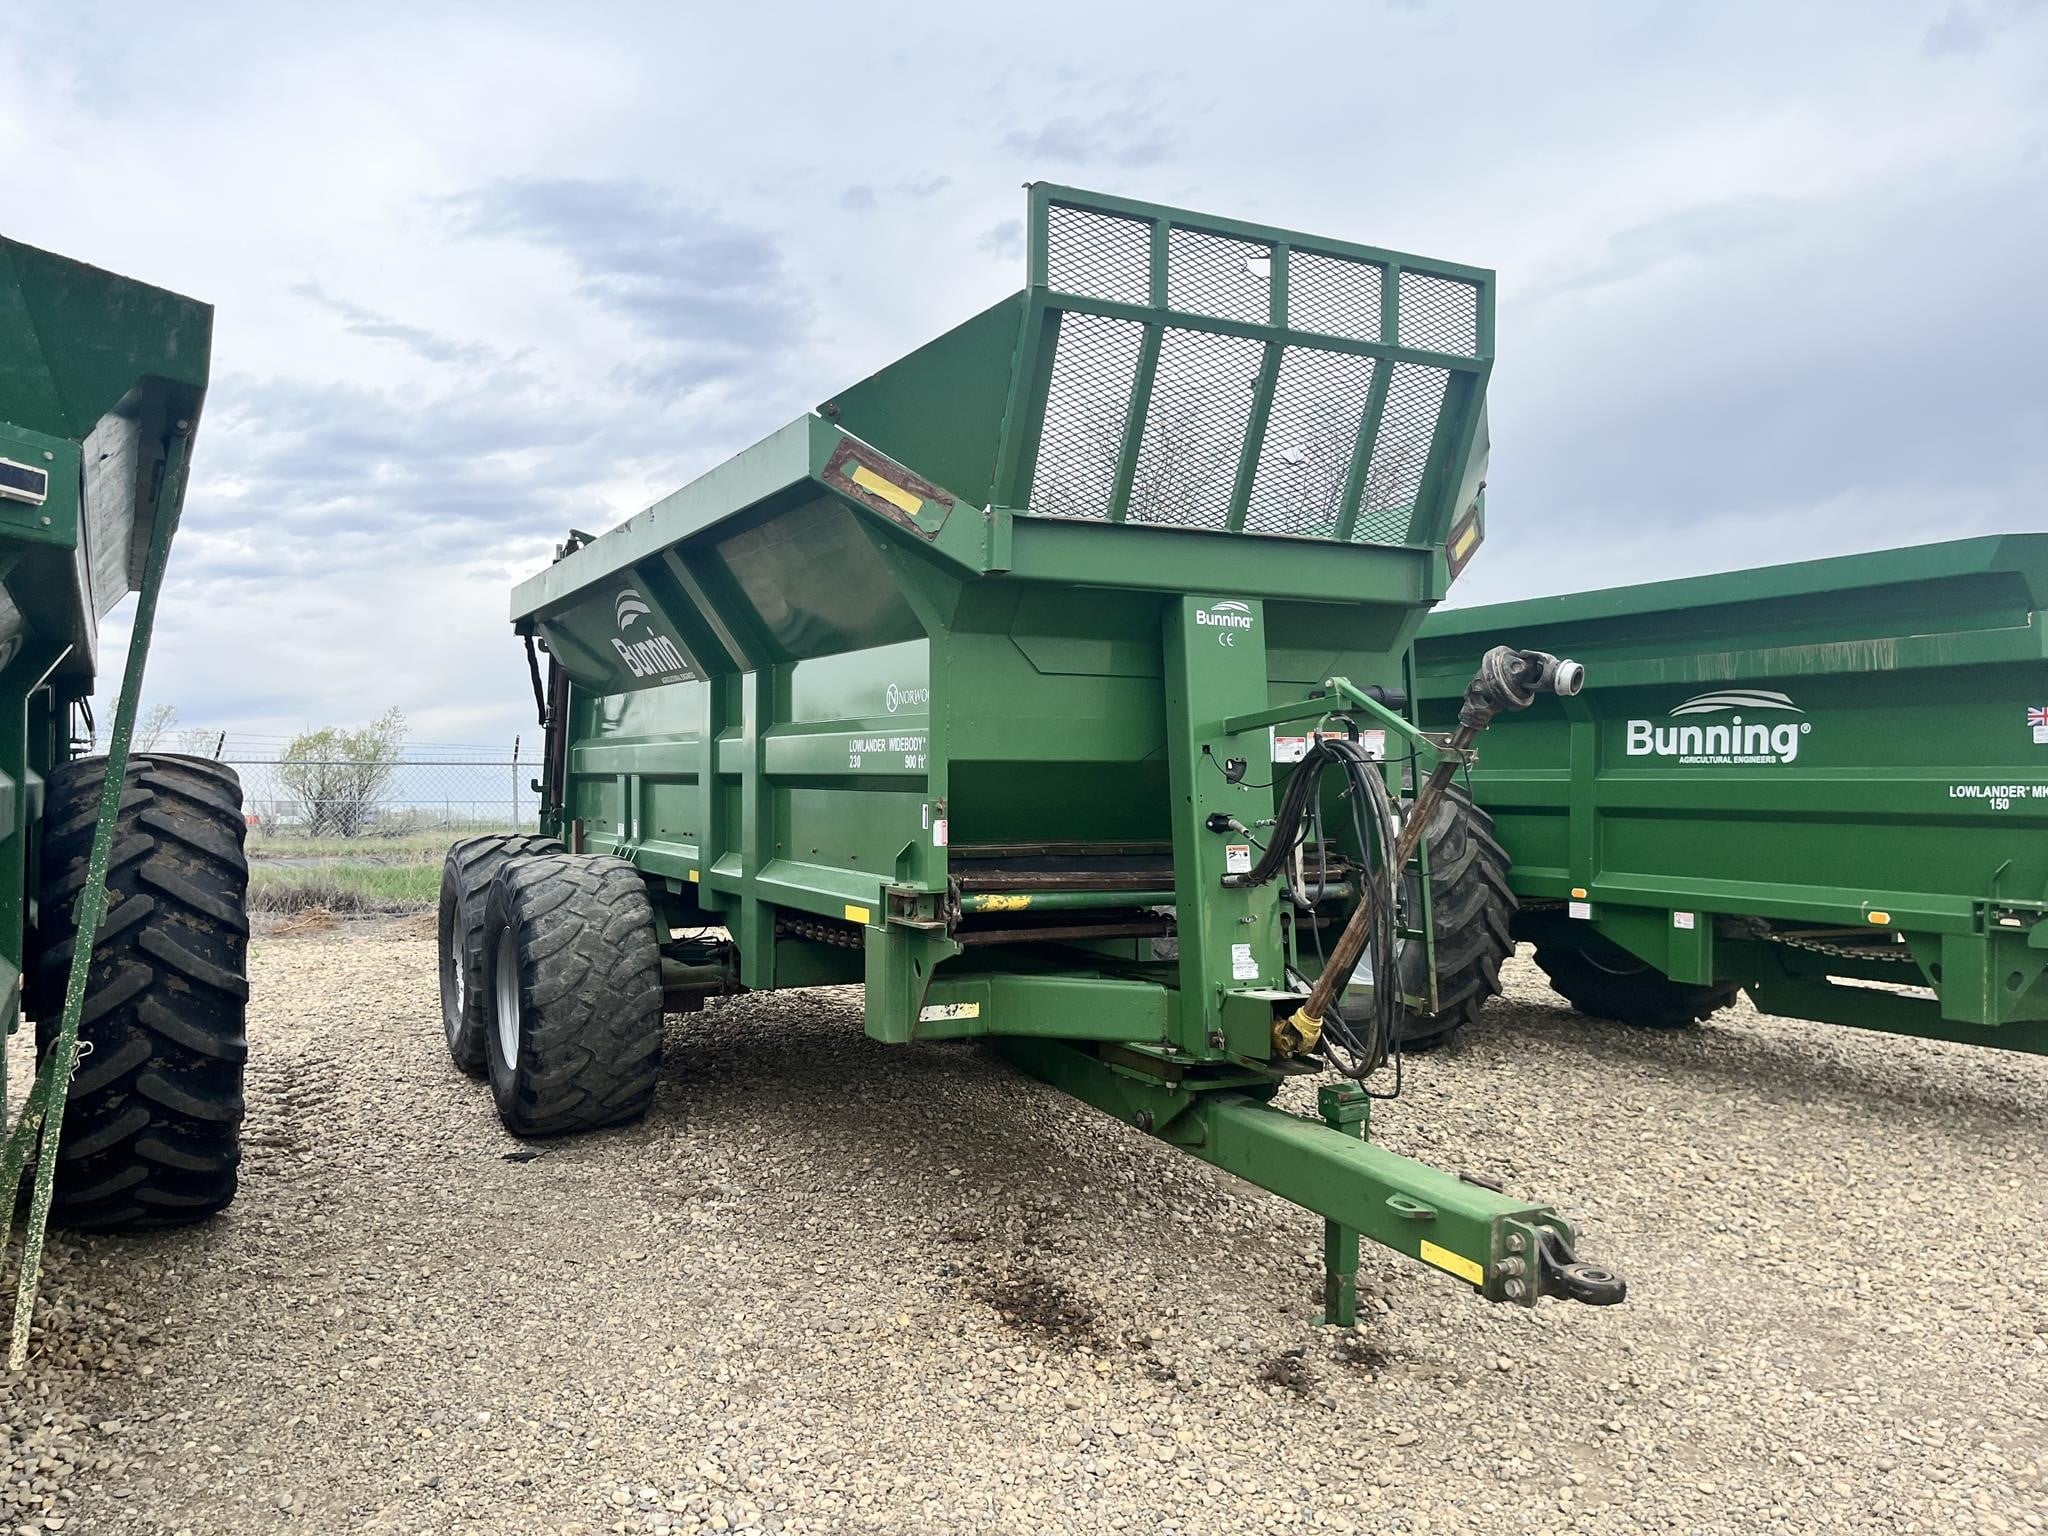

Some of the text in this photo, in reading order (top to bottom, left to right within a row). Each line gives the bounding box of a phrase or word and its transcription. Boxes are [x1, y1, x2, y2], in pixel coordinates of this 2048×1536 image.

[1196, 609, 1251, 631] Bunning
[898, 688, 930, 705] NORWO
[849, 738, 886, 752] LOWLANDER
[849, 754, 861, 768] 230
[904, 754, 917, 768] 900
[1678, 755, 1777, 764] AGRICULTURAL ENGINEERS
[1989, 797, 2010, 810] 150
